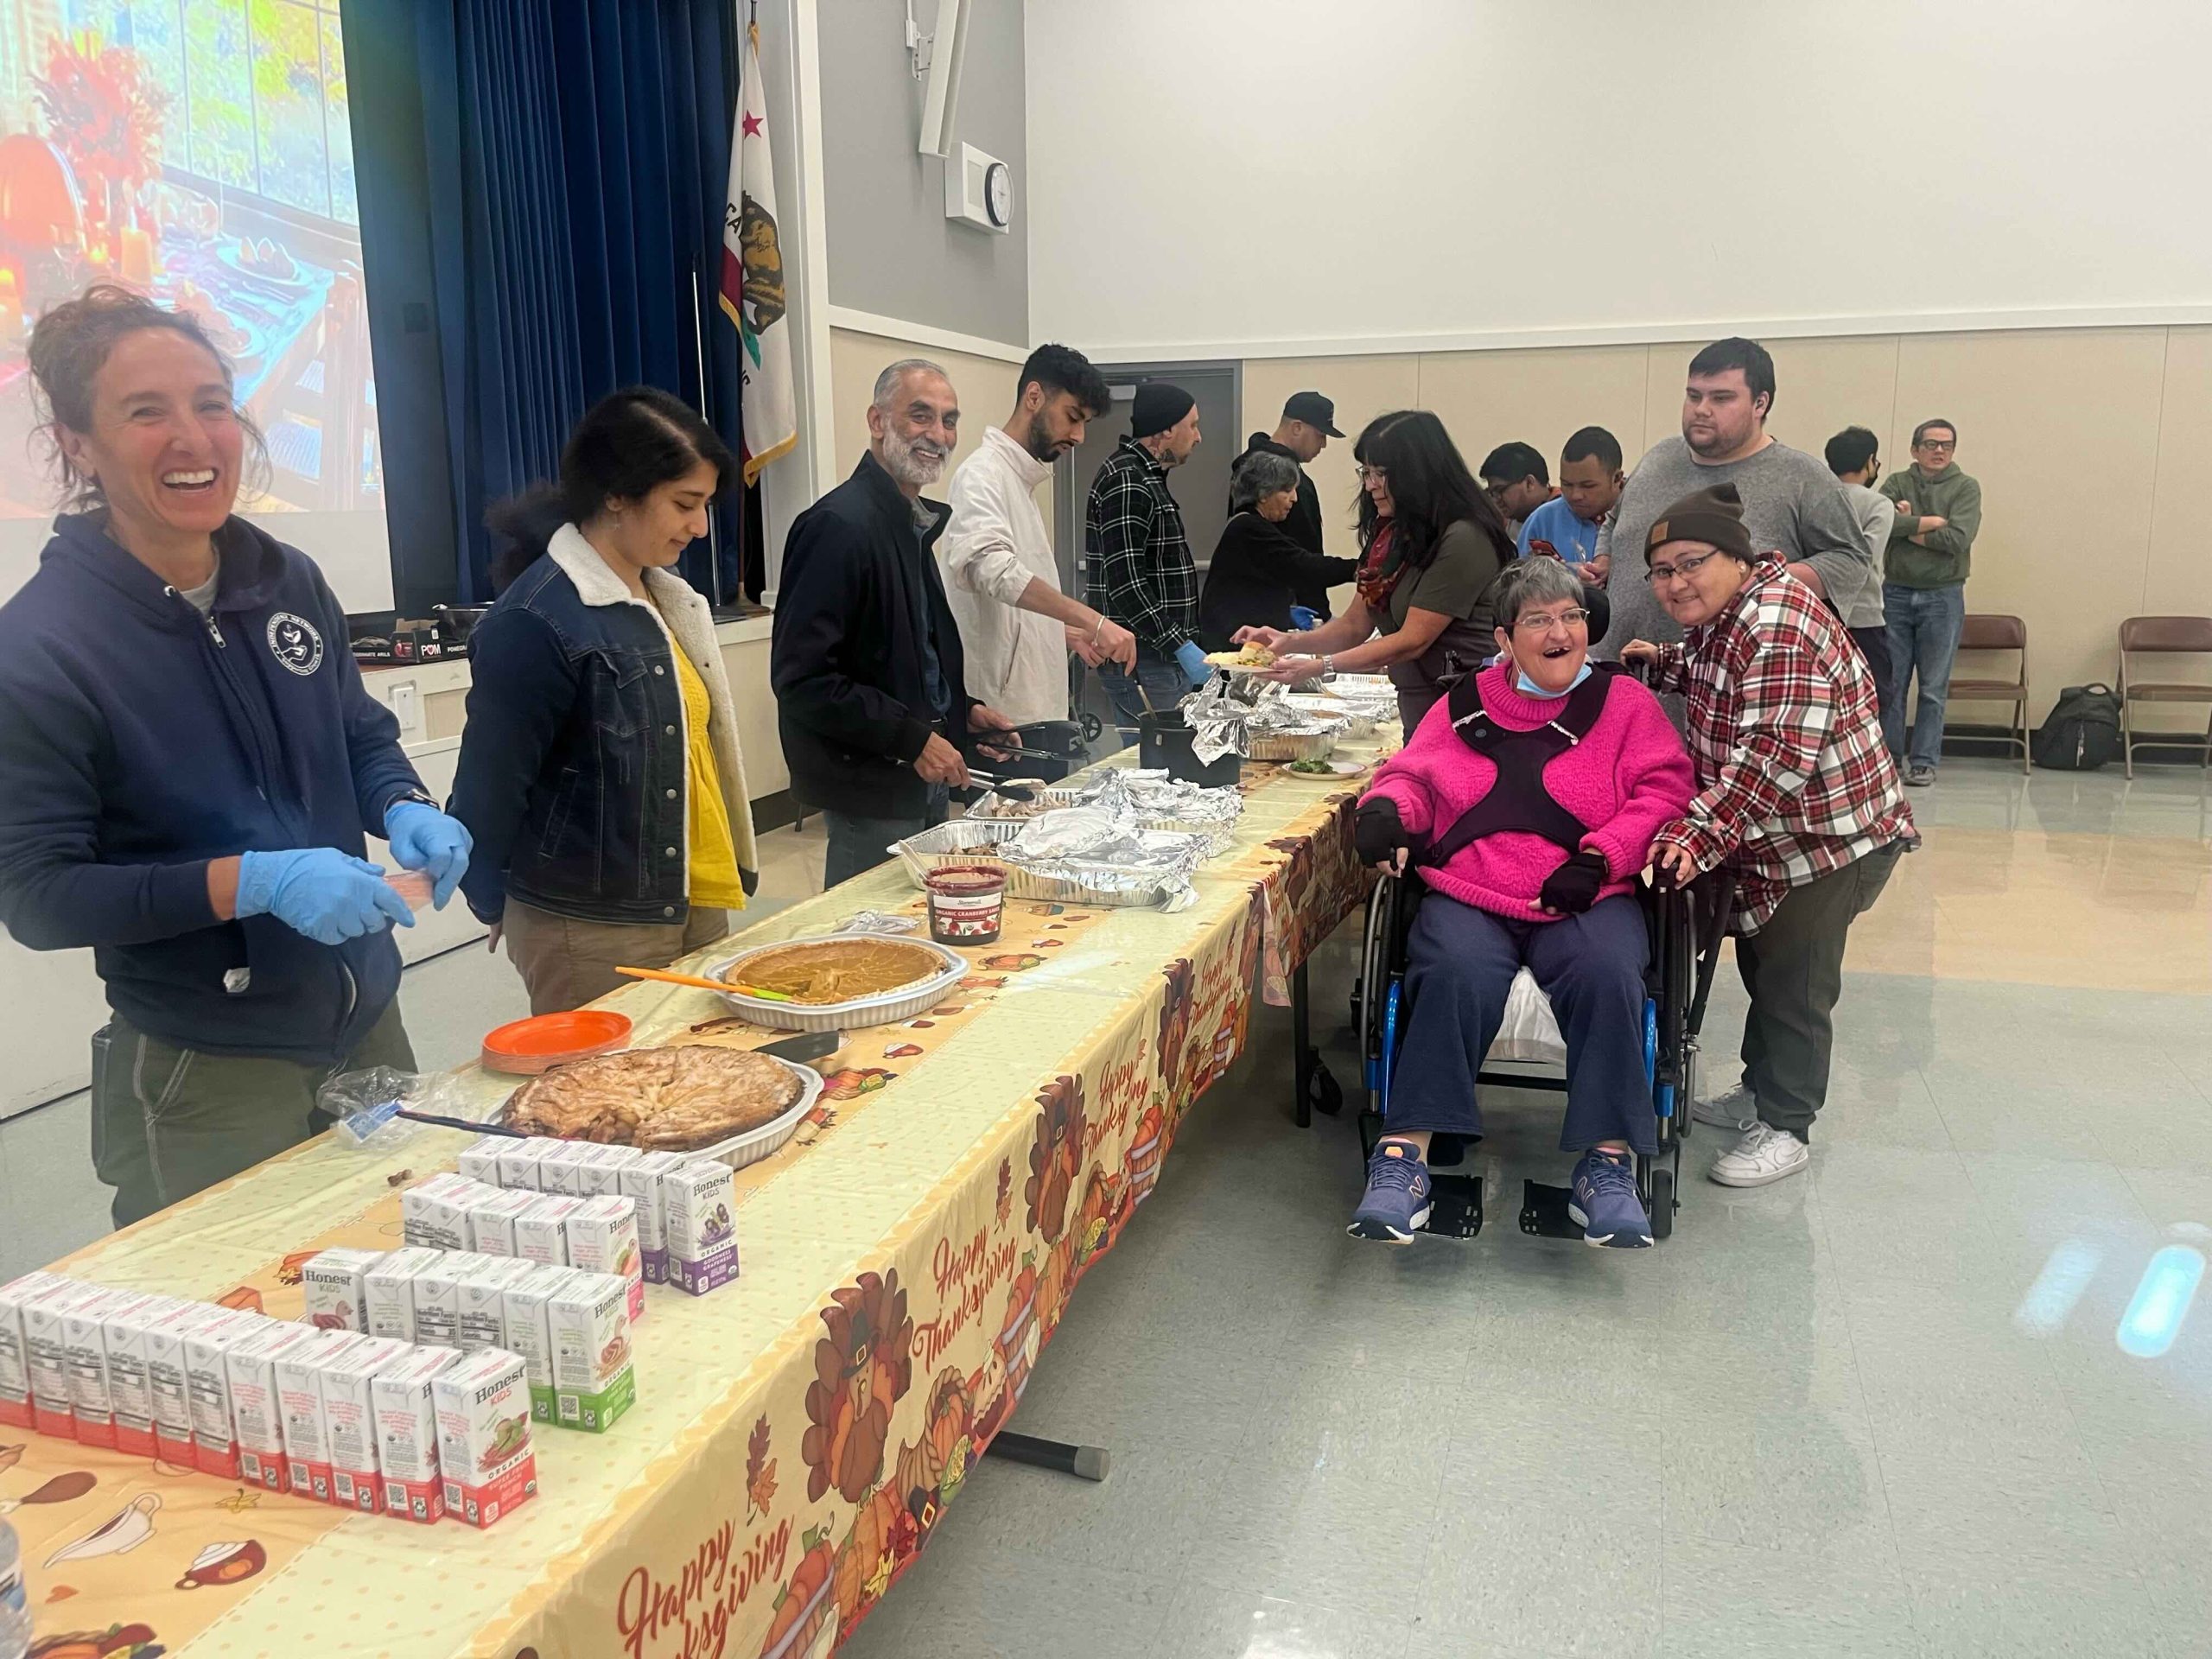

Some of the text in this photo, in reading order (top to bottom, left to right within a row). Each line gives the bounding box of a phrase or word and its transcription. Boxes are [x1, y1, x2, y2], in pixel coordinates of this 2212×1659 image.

[447, 644, 467, 653] POMEGRA
[694, 1173, 732, 1197] Honest
[702, 1187, 720, 1200] KIDS
[701, 1239, 733, 1257] ORGANIC
[934, 1224, 988, 1303] Happy
[304, 1270, 352, 1287] Honest
[319, 1283, 341, 1293] KIDS
[594, 1285, 626, 1319] Honest
[912, 1236, 1019, 1375] Thanksgiving
[475, 1364, 526, 1405] Honest
[490, 1387, 512, 1407] KIDS
[488, 1448, 530, 1479] ORGANIC
[618, 1517, 735, 1659] Happy
[677, 1514, 794, 1659] ksgiving
